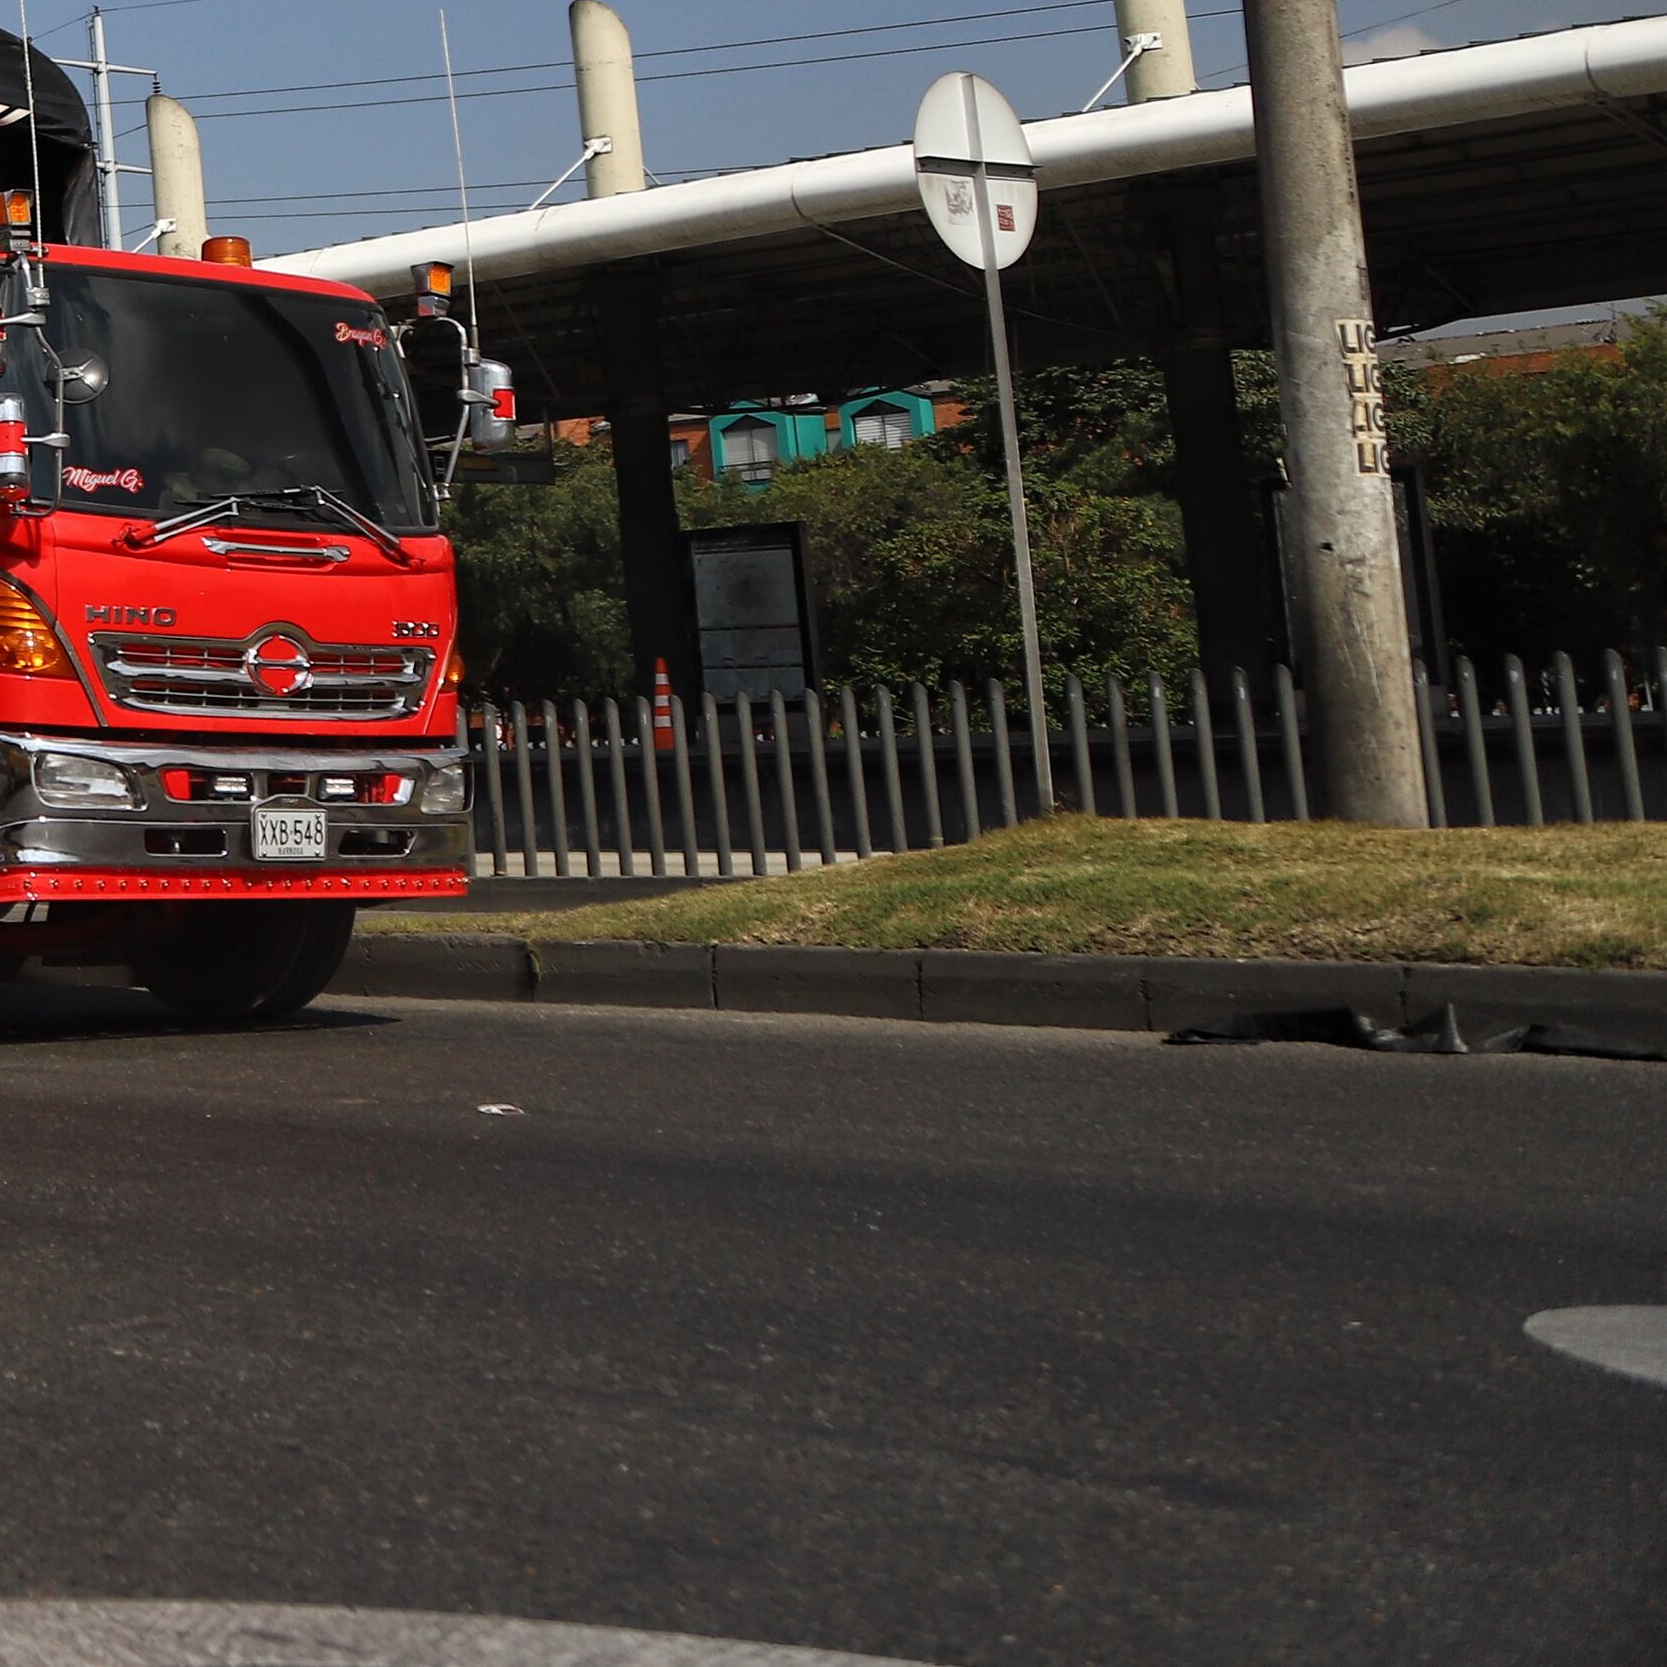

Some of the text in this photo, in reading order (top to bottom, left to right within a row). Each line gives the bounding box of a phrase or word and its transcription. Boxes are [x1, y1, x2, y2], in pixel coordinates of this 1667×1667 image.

[62, 466, 121, 492] Miguel
[85, 604, 177, 627] HINO
[259, 819, 324, 846] XXB 548
